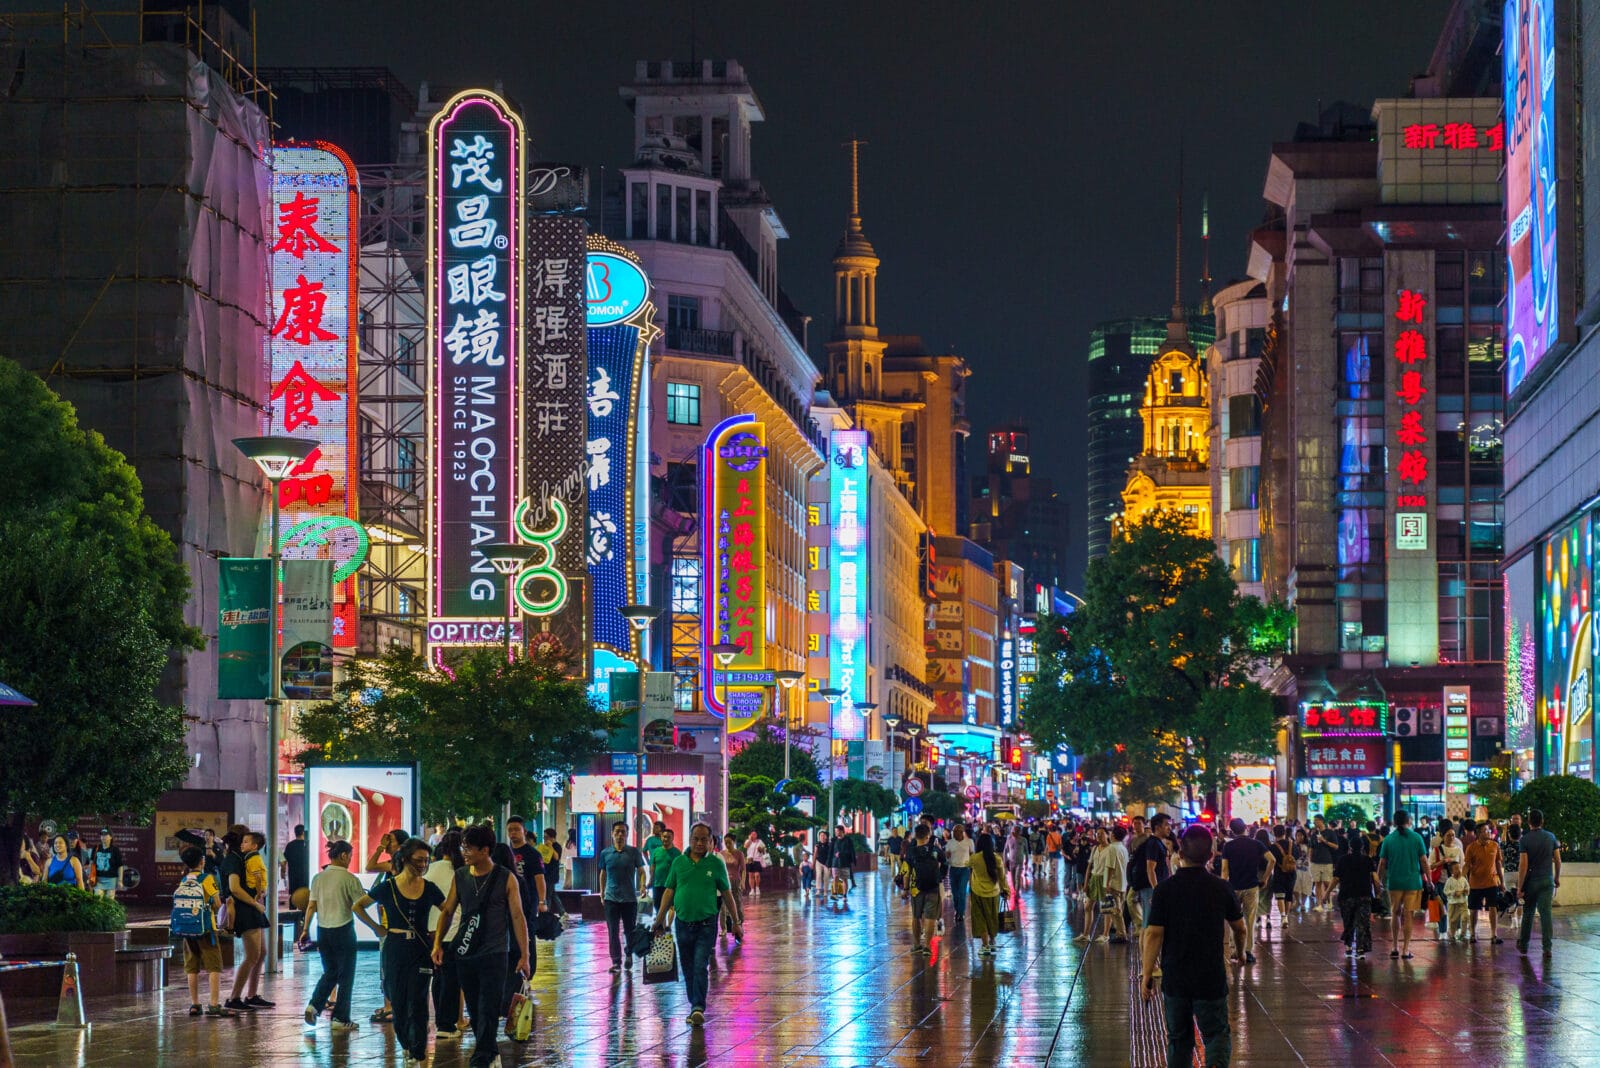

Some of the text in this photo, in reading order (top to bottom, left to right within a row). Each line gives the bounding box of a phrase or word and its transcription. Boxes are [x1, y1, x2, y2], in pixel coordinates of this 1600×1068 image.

[443, 134, 507, 367] 茂昌眼镜
[270, 190, 342, 509] 泰康食品
[587, 305, 624, 315] OMON
[453, 375, 467, 481] SINCE 1923
[1393, 288, 1428, 486] 新雅粤菜馆
[1396, 495, 1427, 507] 1926
[429, 623, 520, 640] OPTICAL
